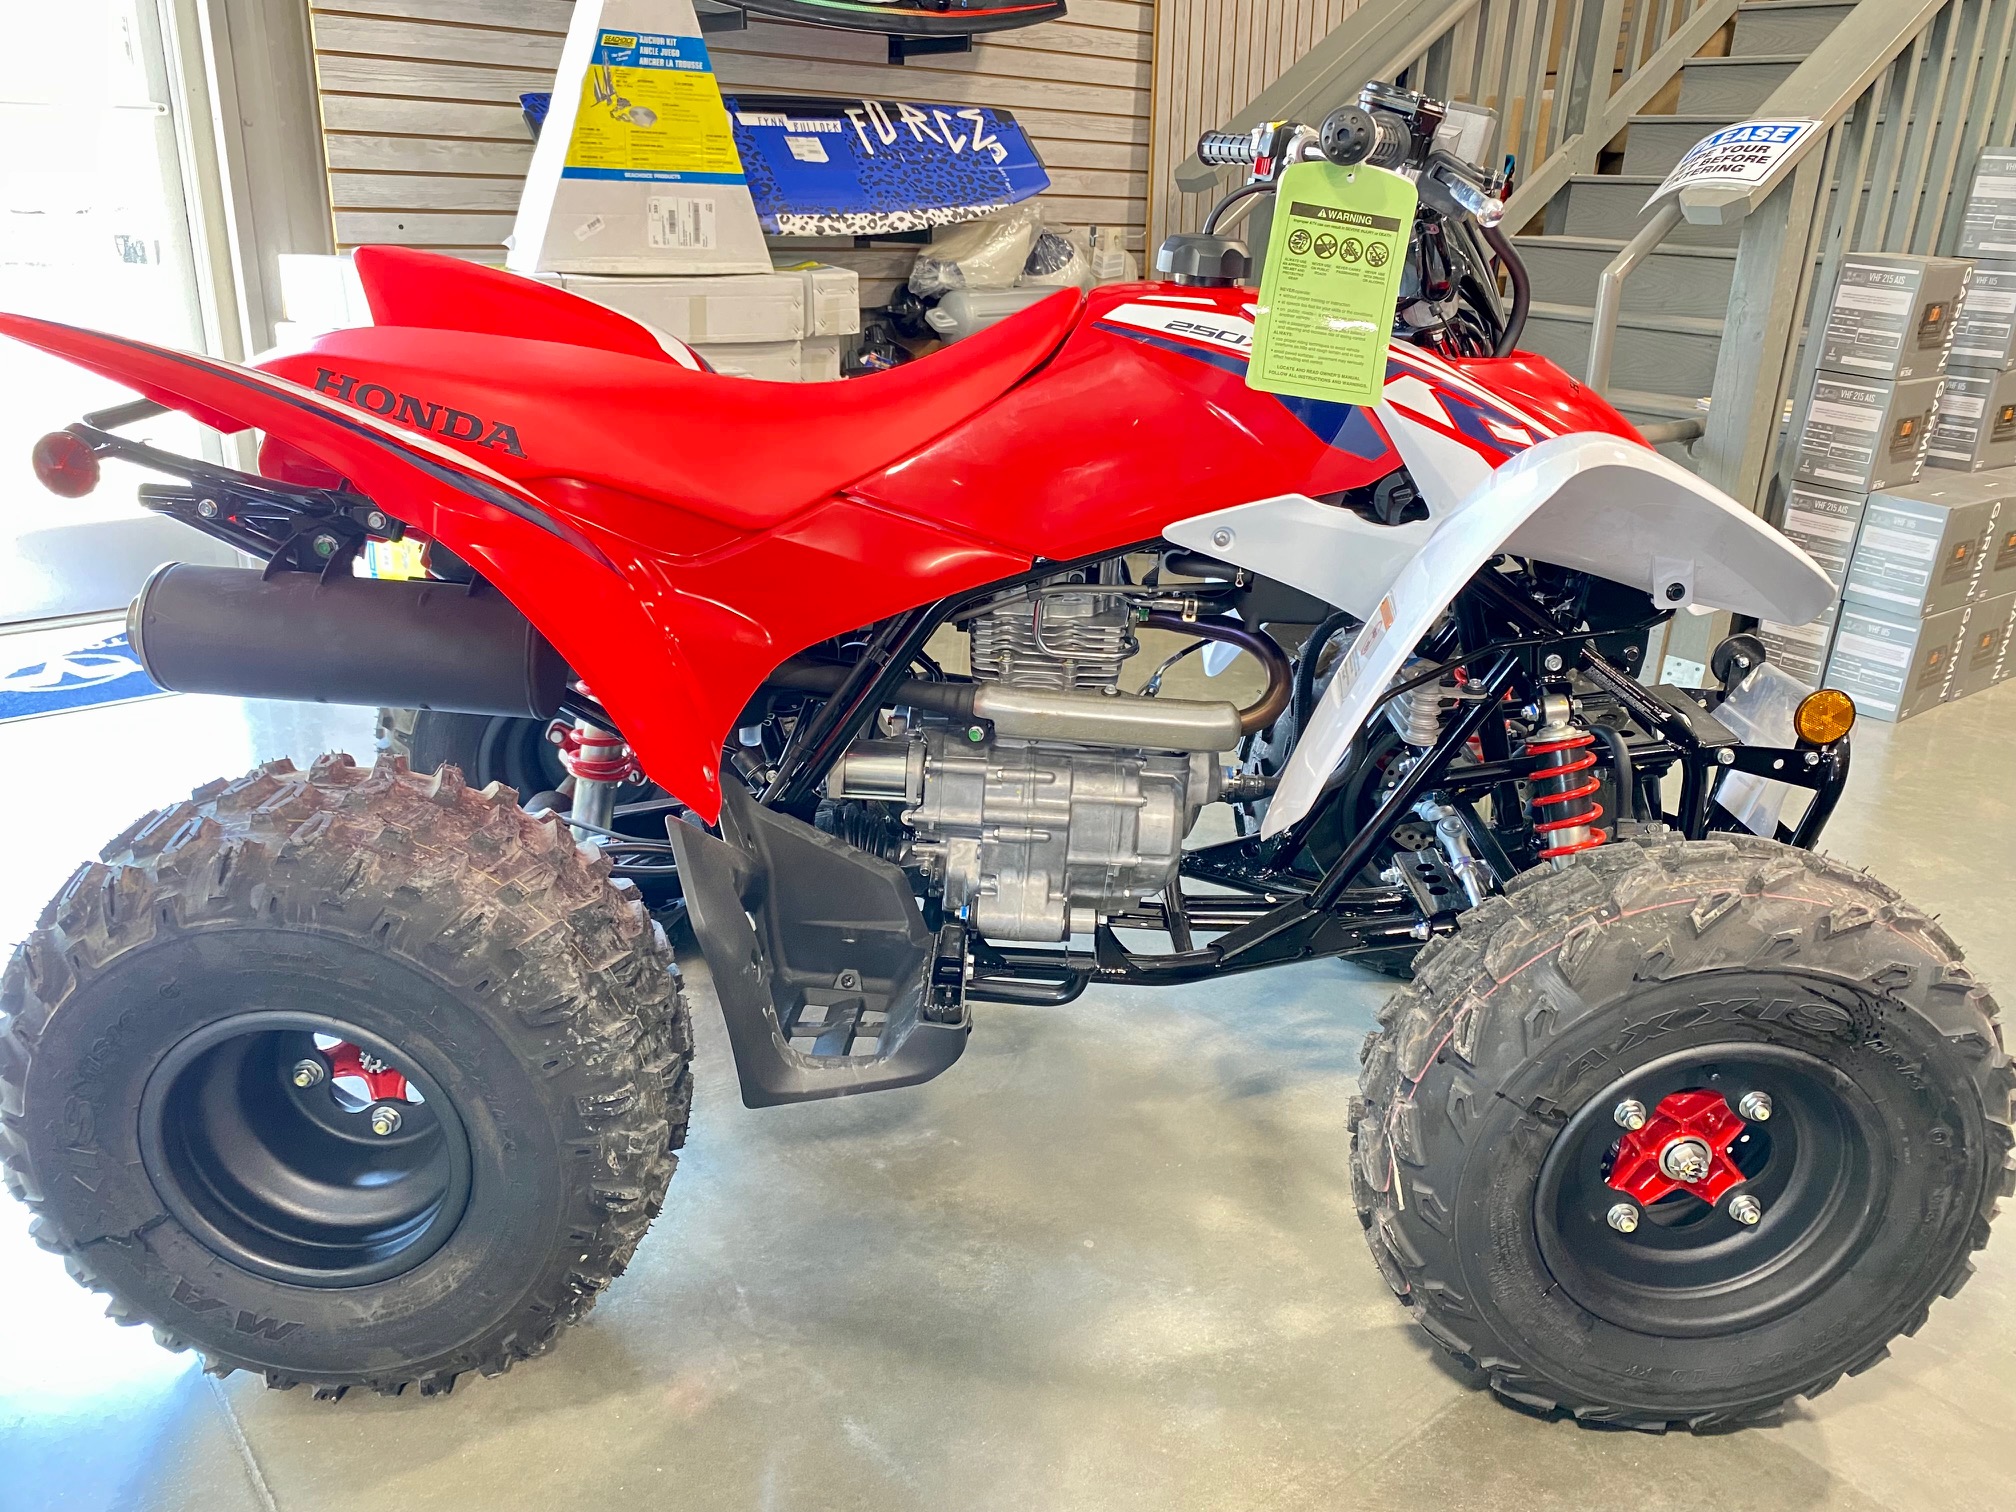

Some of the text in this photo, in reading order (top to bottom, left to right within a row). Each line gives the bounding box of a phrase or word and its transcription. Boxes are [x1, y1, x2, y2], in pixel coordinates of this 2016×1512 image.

[640, 36, 677, 46] ANCHOR KIT
[640, 46, 659, 56] ANCLE
[660, 48, 680, 58] JUEGO
[639, 57, 703, 70] ANCRER LA TROUSSE
[793, 122, 840, 132] BULLOCK
[1720, 145, 1771, 154] YOUR
[1699, 154, 1771, 166] BEFORE
[1328, 209, 1372, 225] WARNING
[1869, 272, 1906, 285] VHF 215 AIS
[1976, 276, 1988, 285] VHF
[1938, 266, 1972, 368] GARMIN
[1298, 374, 1331, 383] INSTRUCTIONS
[1841, 390, 1876, 403] VHF 215 AIS
[314, 368, 528, 460] HONDA
[1912, 381, 1945, 476] GARMIN
[1814, 501, 1849, 514] VHF 215 AIS
[1967, 502, 2001, 597] GARMIN
[1868, 624, 1880, 635] VHF
[1940, 608, 1971, 698] GARMIN
